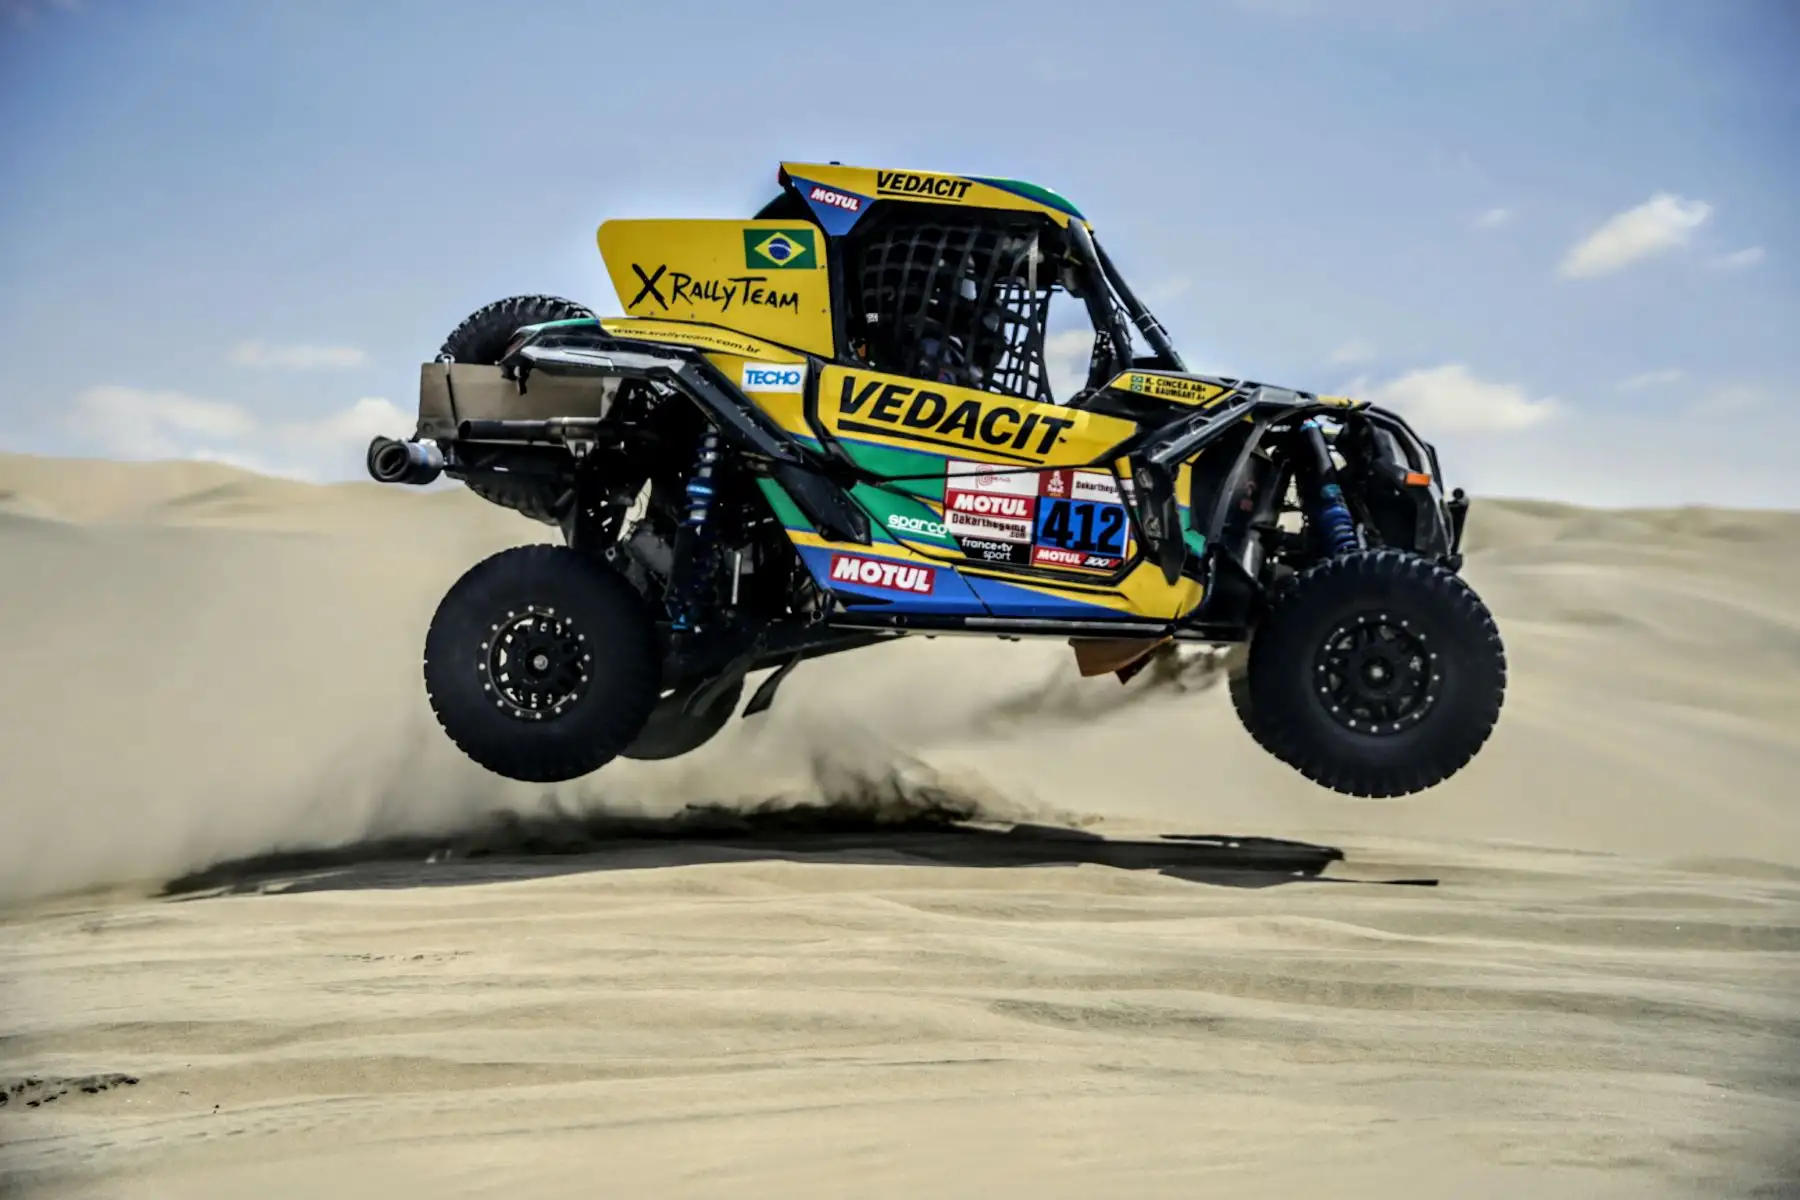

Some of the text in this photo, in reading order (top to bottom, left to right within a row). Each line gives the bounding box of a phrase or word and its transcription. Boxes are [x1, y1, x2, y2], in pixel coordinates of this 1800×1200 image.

[876, 171, 972, 198] VEDACIT
[810, 188, 860, 211] MOTUL
[628, 263, 670, 311] X
[746, 370, 801, 385] TECHO
[839, 376, 1075, 454] VEDACIT
[953, 494, 1028, 517] MOTUL
[888, 514, 947, 535] sparco
[952, 513, 1027, 533] Dakarthegame
[1042, 501, 1124, 554] 412
[983, 550, 1012, 562] sport
[1037, 549, 1081, 564] MOTUL
[832, 557, 931, 592] MOTUL
